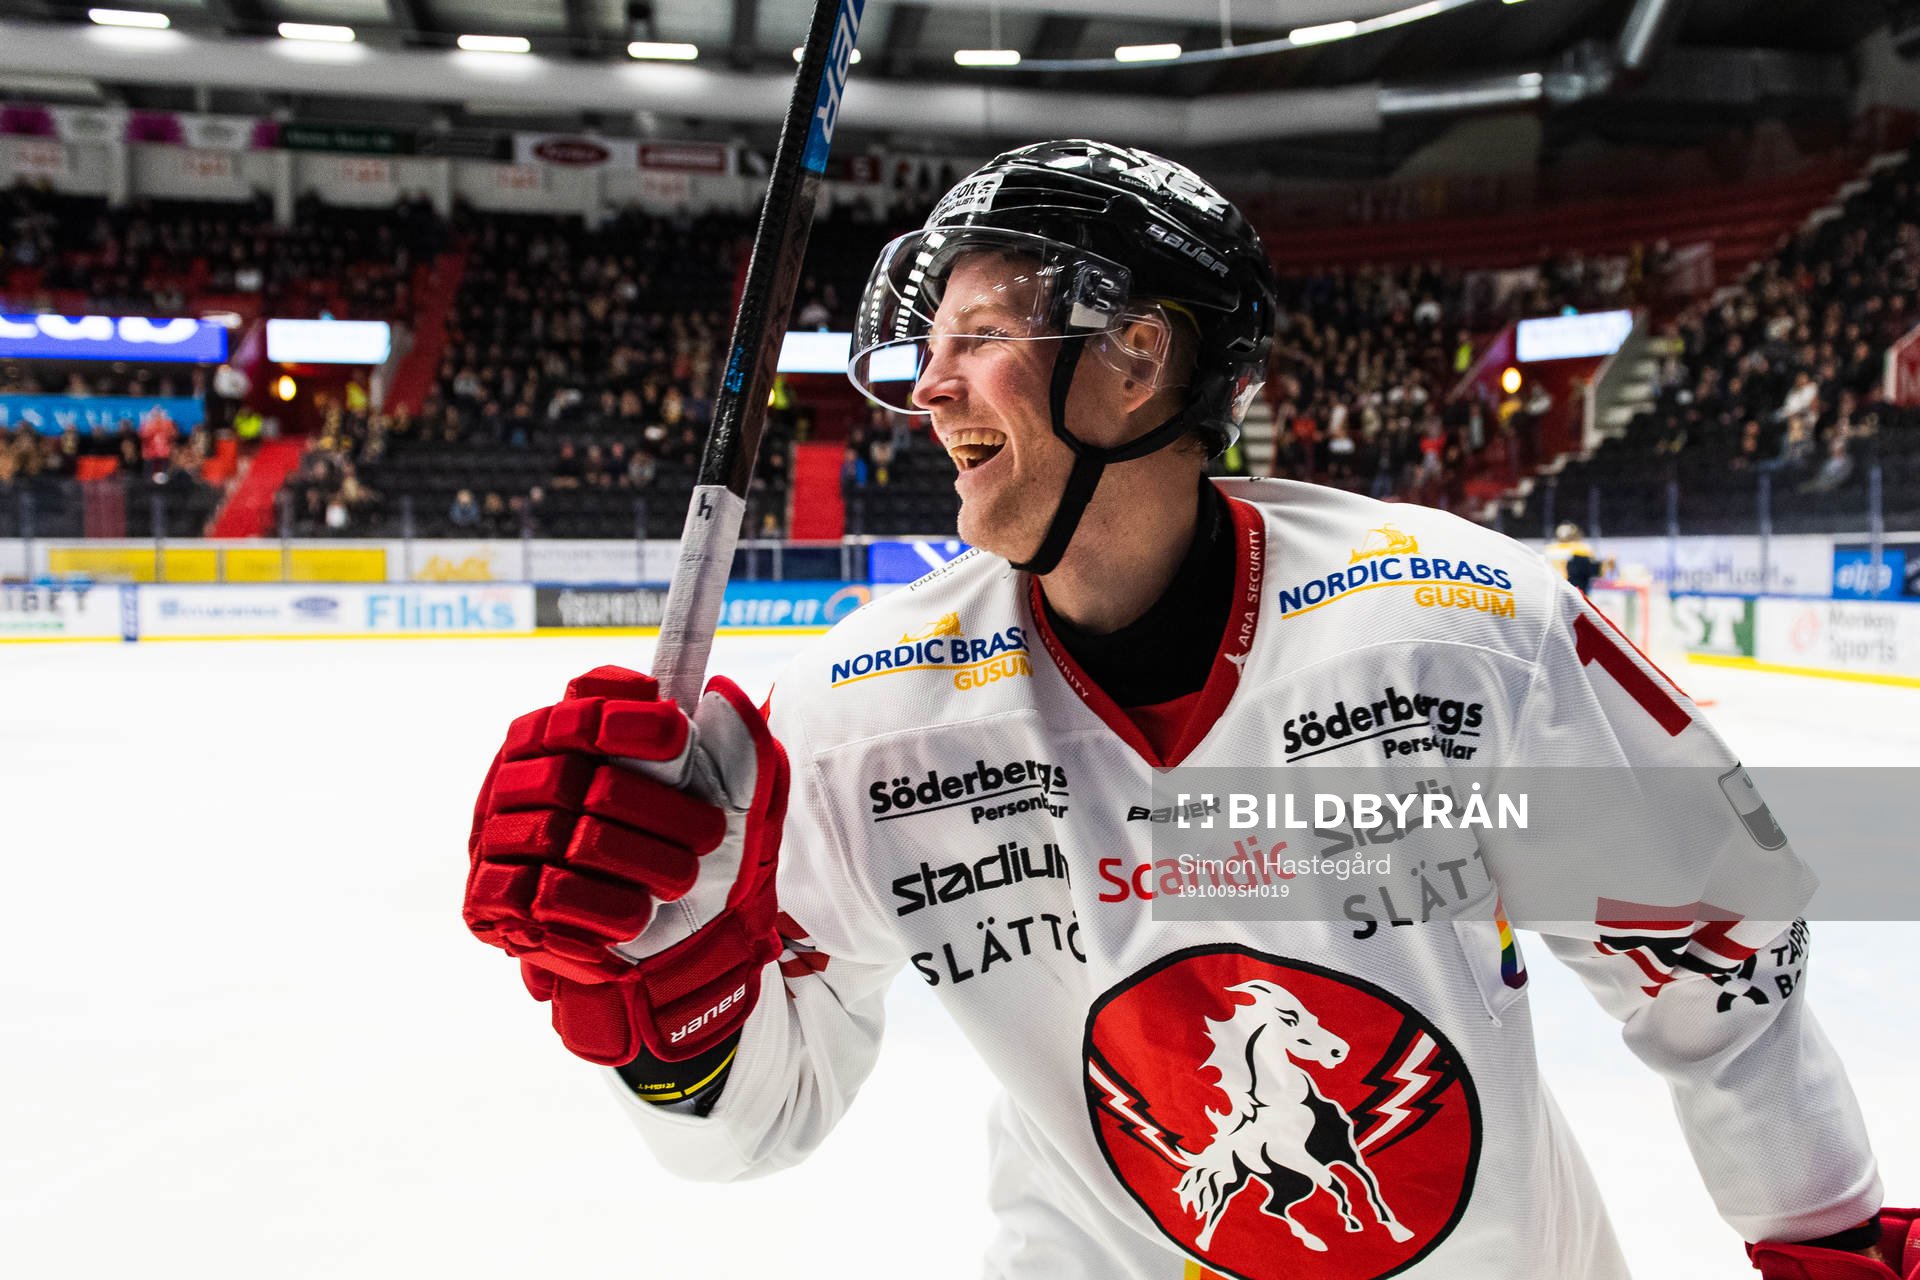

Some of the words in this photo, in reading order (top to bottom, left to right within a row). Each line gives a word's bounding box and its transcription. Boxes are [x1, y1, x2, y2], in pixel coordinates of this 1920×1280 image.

[1238, 611, 1256, 648] ARA
[1247, 528, 1261, 603] SECURITY
[1278, 557, 1403, 614] NORDIC
[1410, 557, 1512, 591] BRASS
[1414, 586, 1516, 619] GUSUM
[367, 594, 517, 630] Flinks
[1829, 602, 1897, 634] Monkey
[831, 639, 945, 683] NORDIC
[1829, 636, 1897, 664] Sports
[1283, 687, 1484, 754] Söderbergs
[869, 760, 1068, 814] Söderbergs
[1098, 835, 1297, 903] Scandic
